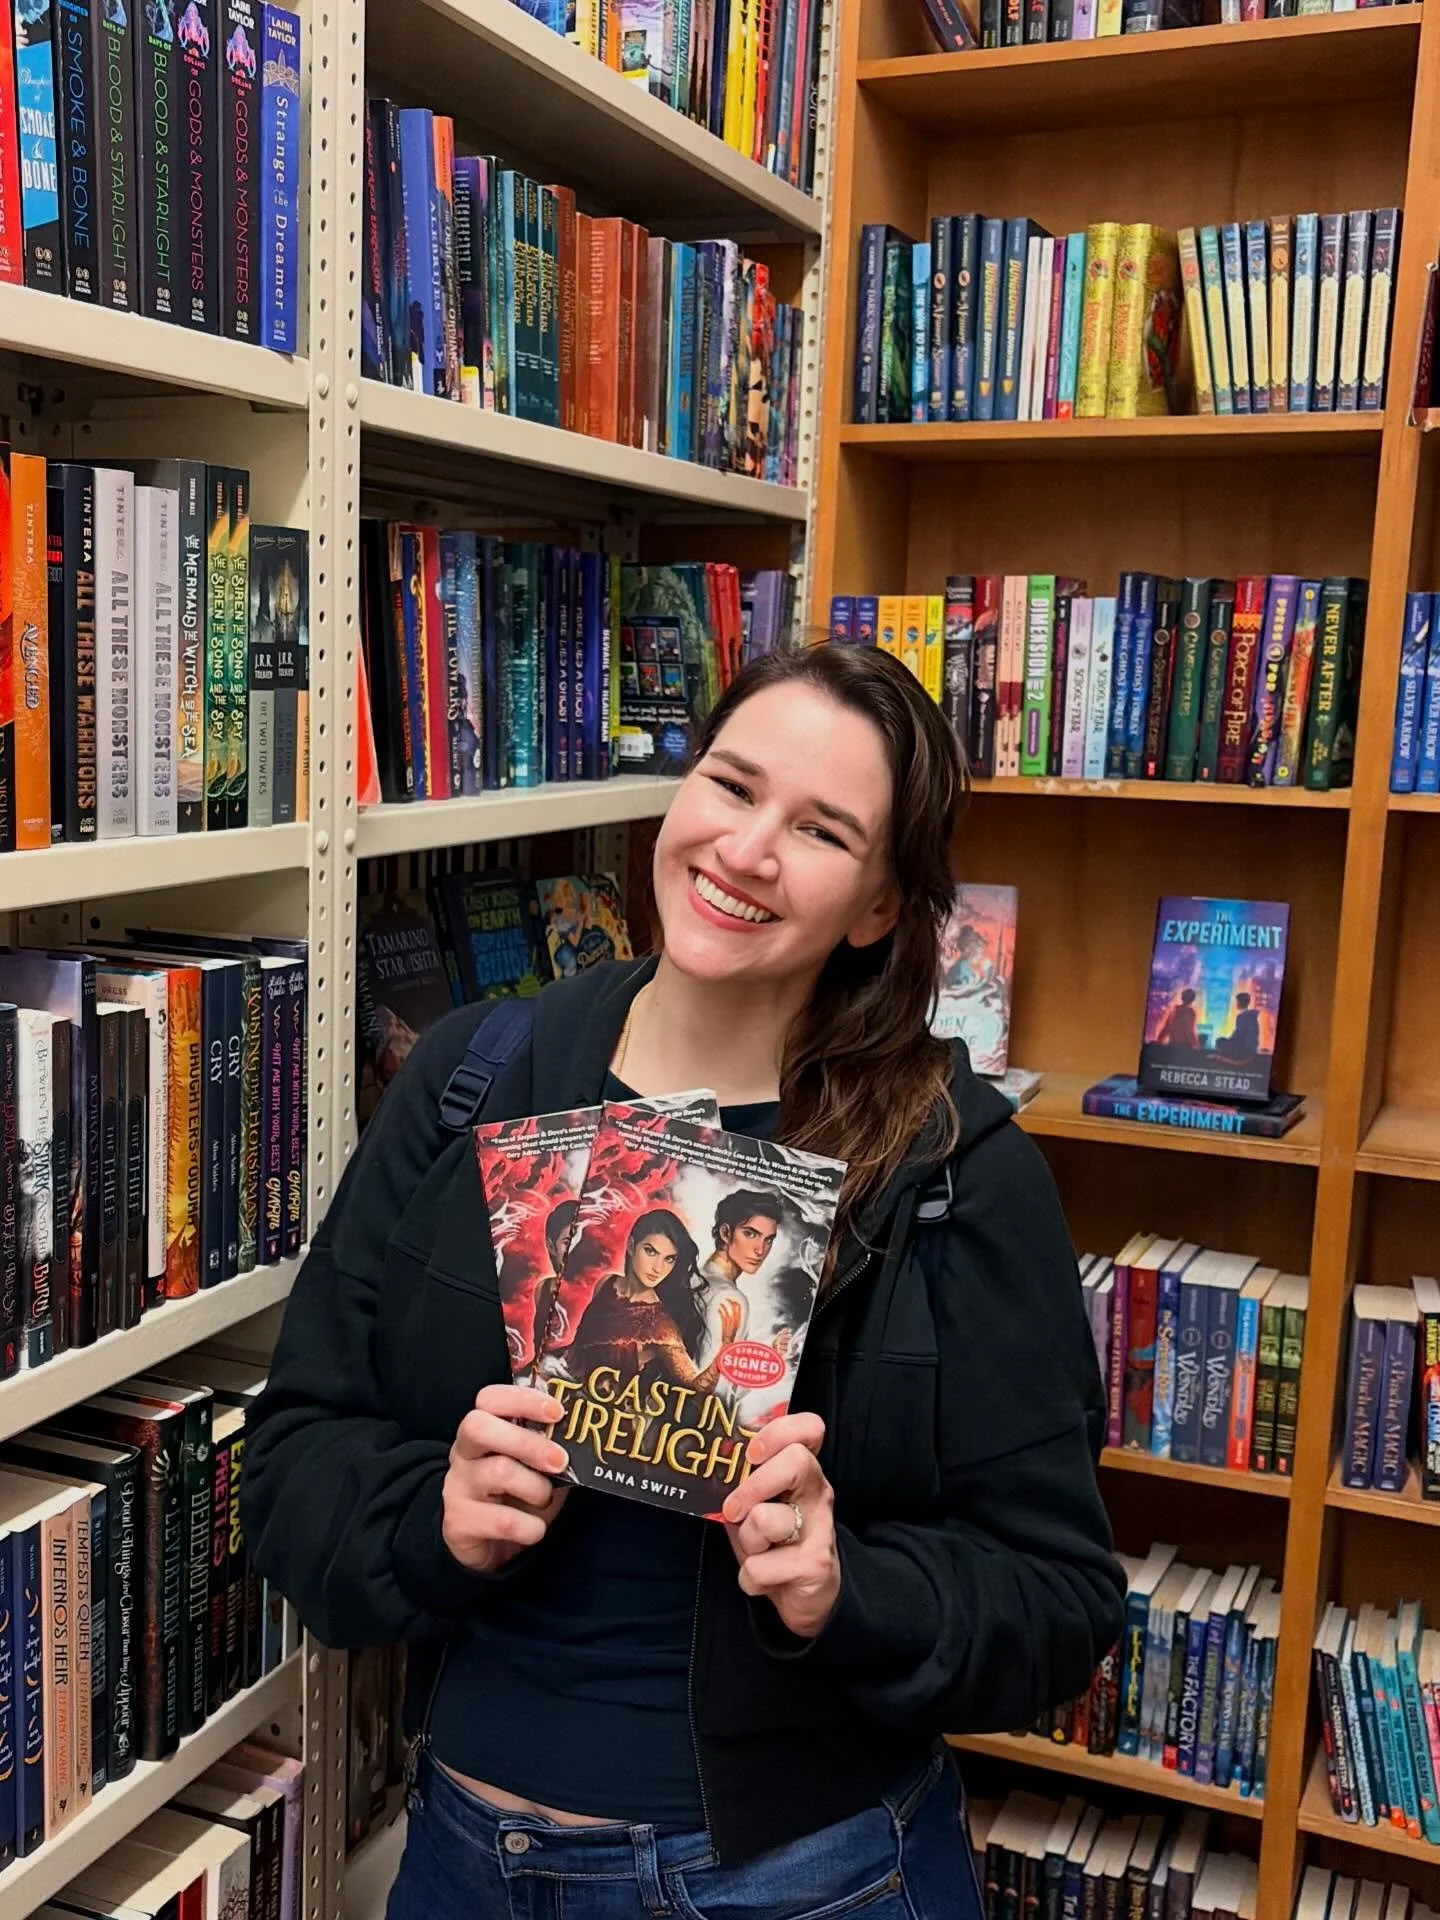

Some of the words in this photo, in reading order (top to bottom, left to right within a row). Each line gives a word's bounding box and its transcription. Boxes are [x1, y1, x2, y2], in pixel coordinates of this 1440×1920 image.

[227, 7, 254, 30] TAYLOR
[267, 27, 297, 47] TAYLOR
[271, 16, 293, 33] LAINI
[68, 28, 86, 135] SMOKE
[107, 37, 123, 124] BLOOD
[154, 52, 170, 137] BLOOD
[20, 107, 55, 139] SMOKE
[188, 79, 202, 147] GODS
[235, 100, 249, 165] GODS
[71, 141, 86, 157] &
[110, 127, 124, 143] &
[155, 140, 170, 156] &
[274, 96, 289, 183] Strange
[23, 158, 57, 193] BONE
[189, 151, 202, 165] &
[236, 168, 249, 181] &
[72, 166, 90, 249] BONE
[110, 148, 126, 273] STARLIGHT
[155, 161, 170, 282] STARLIGHT
[190, 172, 204, 292] MONSTERS
[235, 188, 249, 304] MONSTERS
[273, 213, 288, 311] Dreamer
[915, 331, 926, 345] TO
[25, 503, 35, 564] TINTERA
[79, 484, 92, 564] TINTERA
[115, 487, 126, 561] TINTERA
[183, 535, 200, 550] THE
[211, 555, 228, 570] THE
[231, 555, 247, 571] THE
[75, 570, 96, 609] ALL
[111, 570, 129, 611] ALL
[153, 582, 172, 624] ALL
[183, 553, 200, 634] MERMAID
[209, 573, 225, 619] SIREN
[231, 573, 246, 620] SIREN
[184, 631, 200, 642] THE
[212, 622, 228, 634] THE
[232, 623, 247, 634] THE
[1029, 597, 1051, 677] DIMENSION
[1322, 603, 1341, 656] NEVER
[77, 619, 96, 688] THESE
[111, 619, 129, 683] THESE
[154, 630, 172, 688] THESE
[183, 643, 200, 699] WITCH
[209, 635, 225, 678] SONG
[231, 636, 245, 679] SONG
[255, 654, 274, 669] J.R.R.
[278, 650, 295, 666] J.R.R.
[1232, 632, 1257, 686] FORCE
[1132, 657, 1145, 691] GHOST
[1318, 660, 1336, 711] AFTER
[181, 699, 194, 712] AND
[184, 711, 201, 724] THE
[259, 701, 269, 717] THE
[1129, 696, 1144, 736] FOREST
[1230, 689, 1245, 710] OF
[1402, 679, 1416, 717] SILVER
[111, 688, 129, 800] MONSTERS
[183, 725, 200, 760] SEA
[209, 708, 225, 740] SPY
[230, 708, 245, 740] SPY
[258, 719, 269, 747] TWO
[1224, 709, 1248, 746] FIRE
[1399, 718, 1412, 760] ARROW
[1424, 718, 1437, 761] ARROW
[77, 695, 96, 809] WARRIORS
[153, 693, 172, 799] MONSTERS
[259, 750, 270, 797] TOWERS
[1162, 919, 1283, 950] EXPERIMENT
[246, 985, 263, 1070] RAISING
[209, 1039, 223, 1085] CRY
[228, 1034, 242, 1079] CRY
[188, 1042, 200, 1152] DAUGHTERS
[271, 1086, 281, 1110] WITH
[291, 1081, 301, 1105] WITH
[1159, 1070, 1209, 1087] REBECCA
[1214, 1075, 1251, 1091] STEAD
[271, 1113, 282, 1142] YOUR
[290, 1107, 301, 1136] YOUR
[1112, 1102, 1132, 1116] THE
[1136, 1099, 1248, 1135] EXPERIMENT
[32, 1140, 51, 1195] SPARK
[271, 1144, 281, 1173] BEST
[290, 1138, 301, 1166] BEST
[56, 1166, 69, 1233] THIEF
[103, 1157, 117, 1215] THIEF
[129, 1154, 142, 1211] THIEF
[266, 1177, 284, 1230] CHARM
[286, 1169, 302, 1222] CHARM
[32, 1262, 50, 1318] BURN
[723, 1354, 781, 1375] SIGNED
[733, 1369, 769, 1381] EDITION
[588, 1366, 697, 1424] CAST
[697, 1394, 741, 1438] IN
[120, 1482, 136, 1527] Dead
[594, 1465, 635, 1488] DANA
[640, 1478, 688, 1501] SWIFT
[115, 1529, 135, 1580] Things
[188, 1488, 211, 1622] BEHEMOTH
[52, 1538, 68, 1638] INFERNO'S
[78, 1604, 91, 1660] QUEEN
[53, 1645, 68, 1686] HEIR
[1187, 1655, 1200, 1676] THE
[1178, 1676, 1201, 1753] FACTORY
